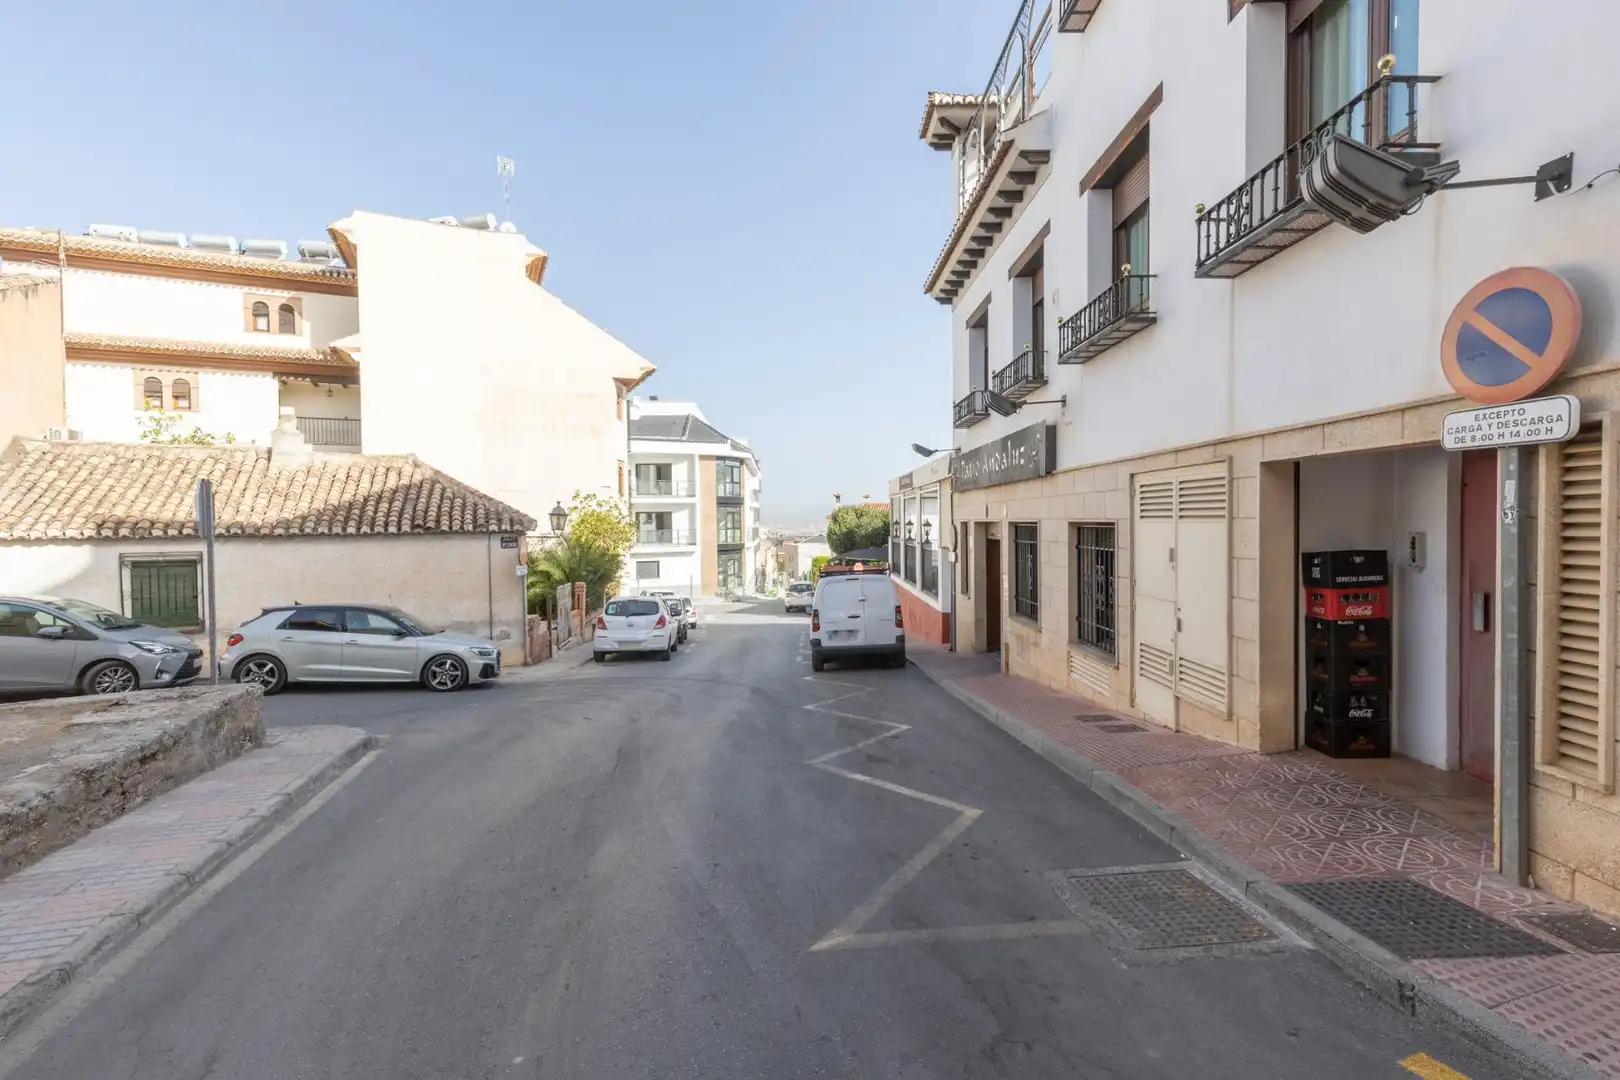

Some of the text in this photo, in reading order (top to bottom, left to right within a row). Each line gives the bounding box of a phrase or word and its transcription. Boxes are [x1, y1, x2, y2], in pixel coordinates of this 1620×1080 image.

[1474, 407, 1526, 422] EXCEPTO
[1447, 414, 1564, 436] CARGA Y DESCARGA
[1454, 435, 1466, 445] DE
[1470, 433, 1494, 443] 8:00
[1497, 431, 1505, 440] H
[1545, 426, 1553, 436] H
